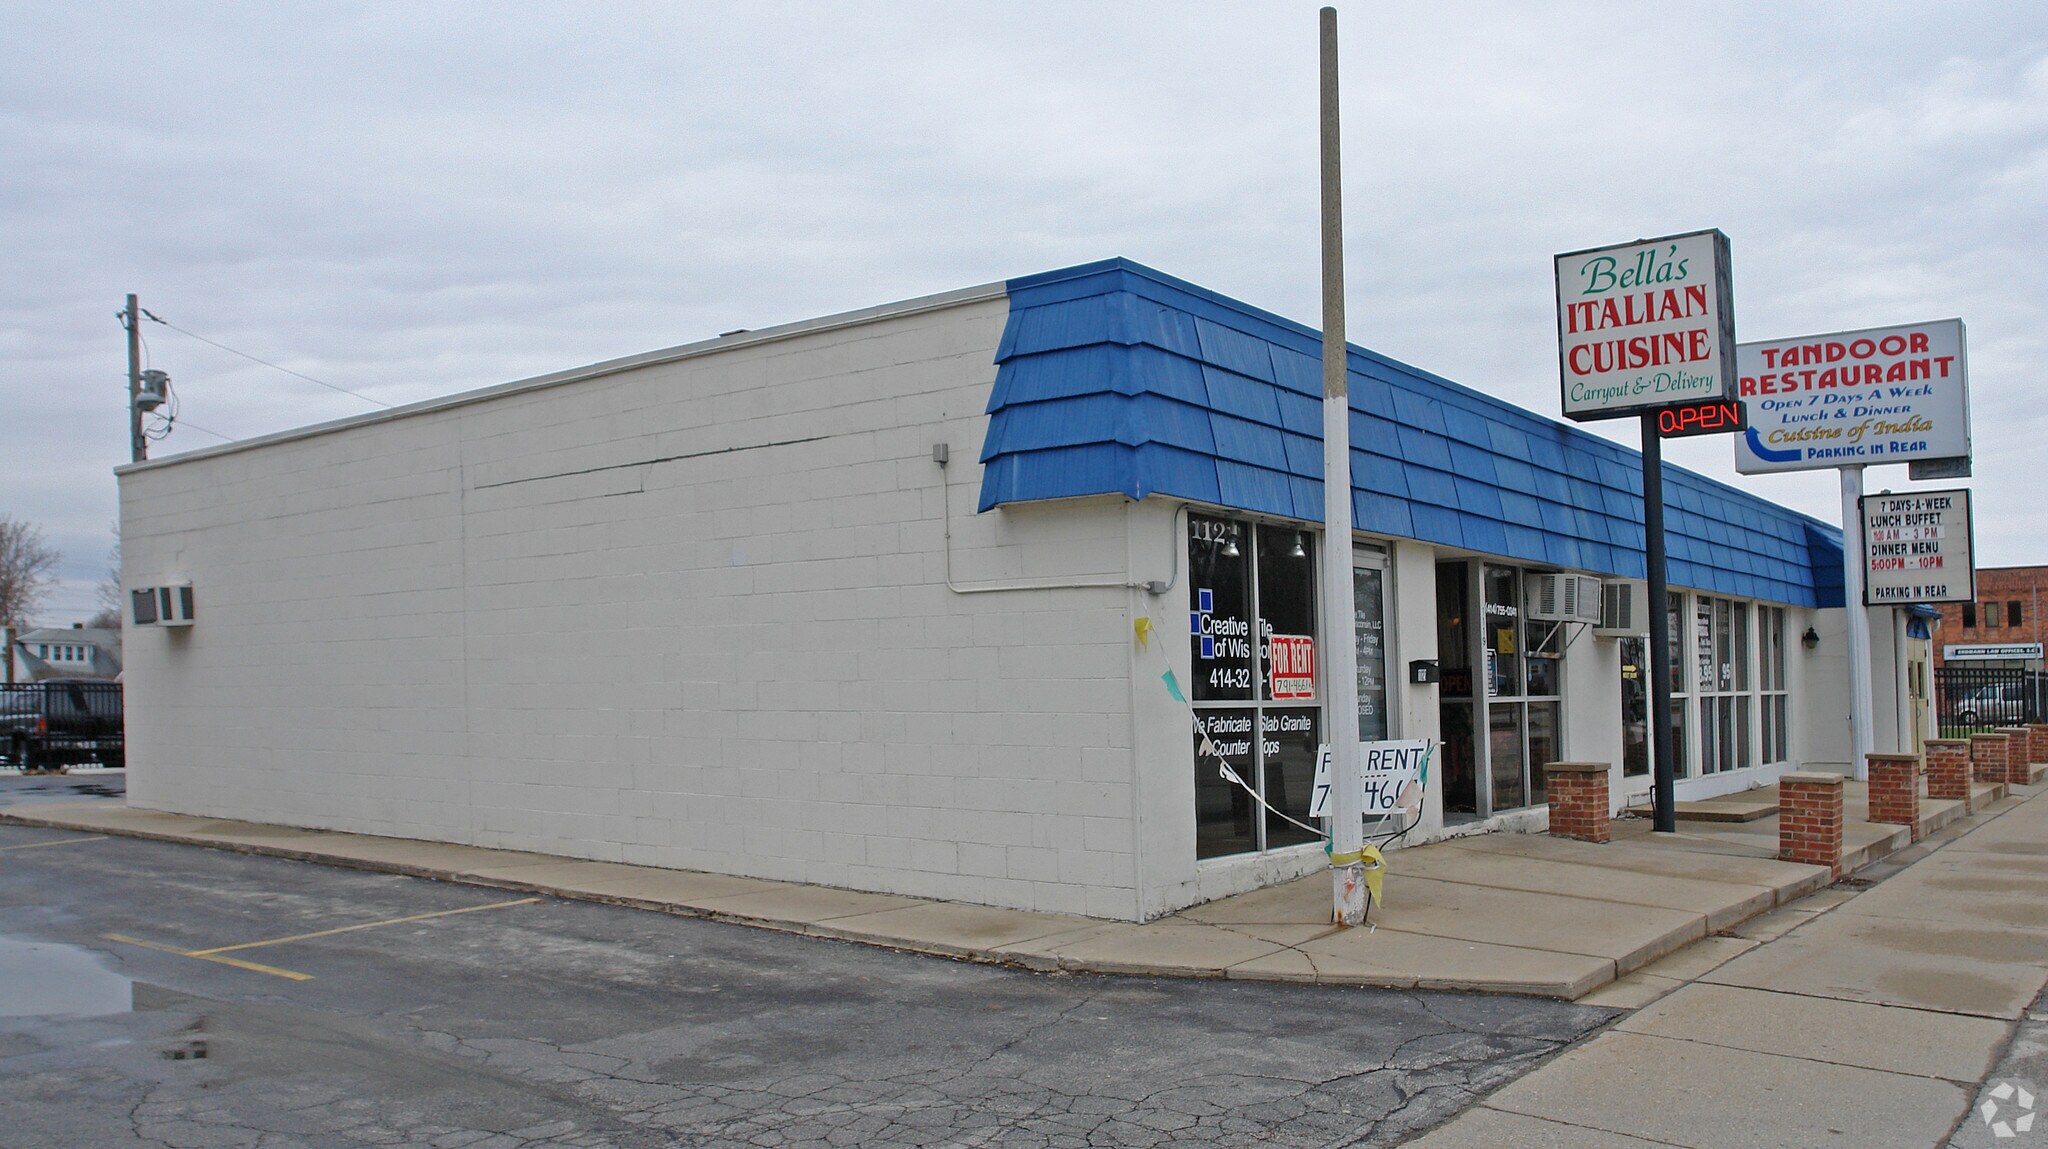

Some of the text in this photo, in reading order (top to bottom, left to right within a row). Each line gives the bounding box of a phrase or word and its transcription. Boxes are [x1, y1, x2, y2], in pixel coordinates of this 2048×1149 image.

[1581, 244, 1689, 295] Bella's
[1567, 284, 1708, 334] ITALIAN
[1569, 328, 1712, 375] CUISINE
[1761, 332, 1929, 369] TANDOOR
[1740, 356, 1955, 397] RESTAURANT
[1570, 371, 1714, 404] Carryout & Delivery
[1808, 395, 1819, 406] 7
[1868, 389, 1882, 400] A
[1659, 402, 1739, 433] OPEN
[1834, 408, 1848, 419] &
[1768, 414, 1933, 444] Cuisine of India
[1881, 497, 1952, 512] 7 DAYS-A-WEEK
[1870, 512, 1941, 528] LUNCH BUFFET
[1886, 529, 1900, 540] AM
[1913, 528, 1919, 540] 3
[1924, 527, 1938, 538] PM
[1871, 541, 1939, 556] DINNER MENU
[1871, 557, 1905, 571] 5:00PM
[1918, 556, 1943, 569] 10PM
[1875, 584, 1947, 599] PARKING IN REAR
[1201, 614, 1248, 636] Creative
[1215, 638, 1226, 658] of
[1272, 642, 1312, 674] FOR RENT
[1358, 705, 1374, 716] OSED
[1207, 715, 1252, 734] Fabricate
[1280, 715, 1312, 732] Granite
[1212, 739, 1250, 756] Counter
[1367, 748, 1424, 771] RENT
